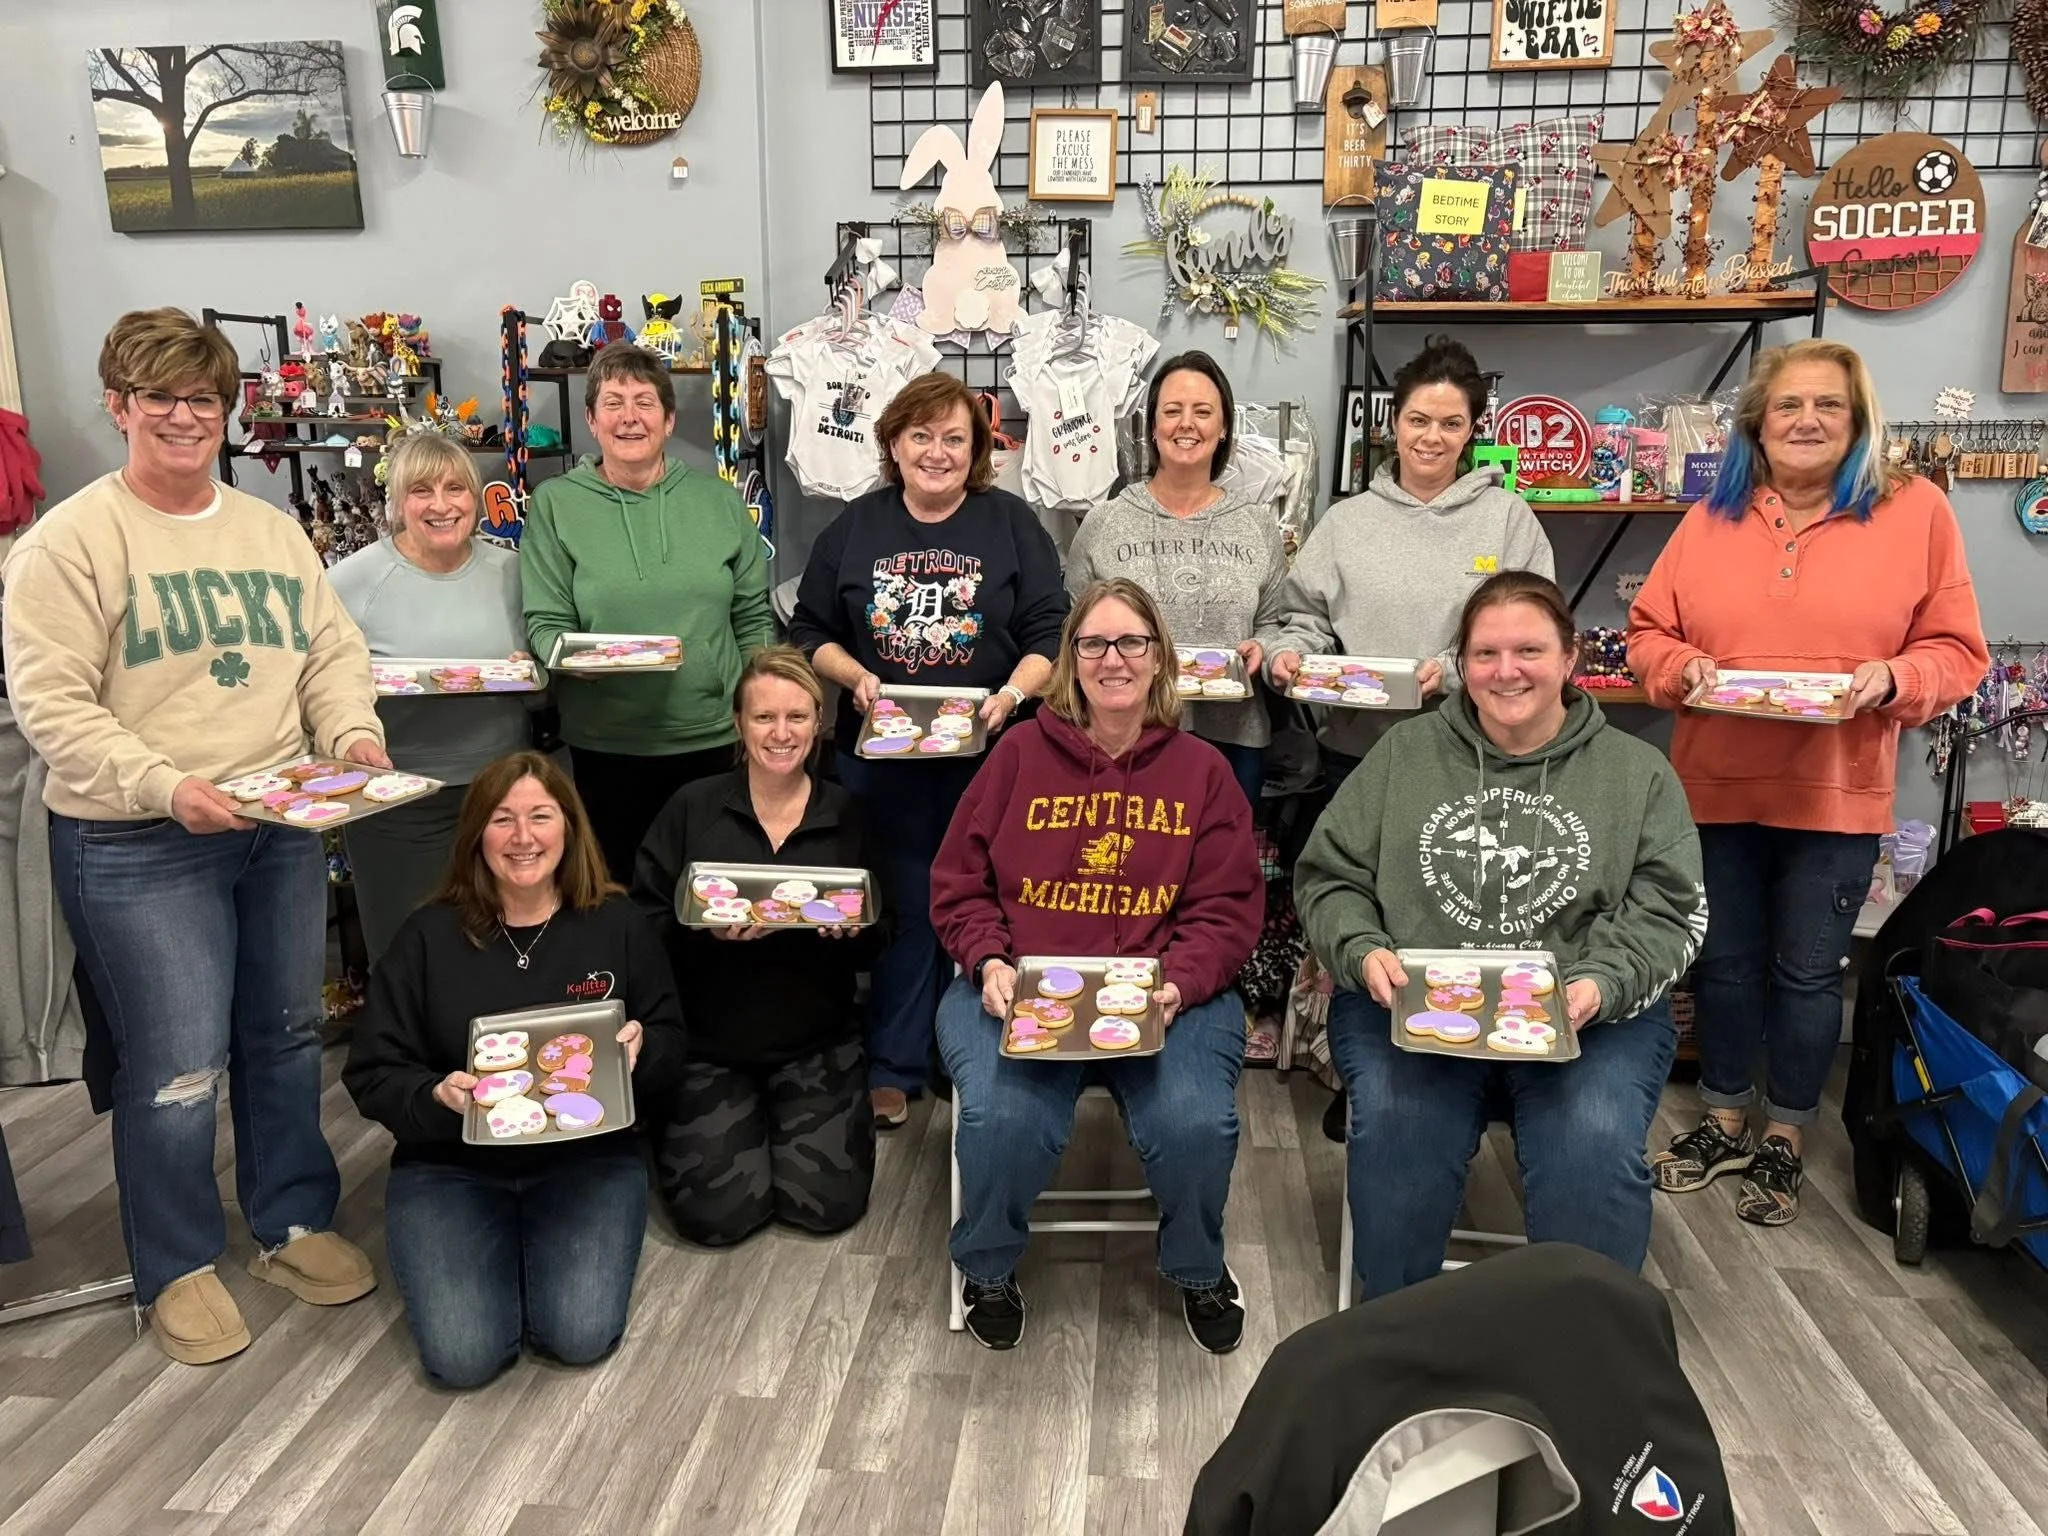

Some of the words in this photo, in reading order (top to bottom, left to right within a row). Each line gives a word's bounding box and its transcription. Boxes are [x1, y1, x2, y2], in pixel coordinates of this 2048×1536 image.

[847, 18, 855, 61] SCRUBS
[914, 4, 923, 62] PATIENT
[1525, 26, 1580, 59] ERA
[606, 108, 682, 131] welcome
[1346, 123, 1365, 135] IT'S
[1056, 130, 1091, 142] PLEASE
[1344, 140, 1366, 152] BEER
[1056, 144, 1091, 156] EXCUSE
[1339, 155, 1372, 168] THIRTY
[1053, 157, 1068, 170] THE
[1072, 157, 1094, 170] MESS
[1833, 165, 1909, 200] Hello
[1432, 194, 1480, 209] BEDTIME
[1434, 214, 1470, 227] STORY
[1812, 198, 1977, 242] SOCCER
[1166, 205, 1296, 288] family
[1562, 253, 1590, 266] WELCOME
[1720, 253, 1798, 288] Blessed
[1564, 267, 1572, 279] TO
[1573, 267, 1586, 279] OUR
[1603, 267, 1679, 294] Thankful
[702, 282, 714, 293] FUCK
[826, 381, 843, 390] BOR
[817, 422, 865, 444] DETROIT!
[1051, 412, 1094, 439] GRANDMA
[1547, 414, 1575, 448] 2
[1518, 452, 1573, 460] INTENDO
[1695, 469, 1719, 477] TAK
[1117, 539, 1185, 562] OUTER
[1192, 538, 1253, 565] BANKS
[873, 548, 981, 579] DETROIT
[1473, 554, 1498, 574] M
[122, 567, 311, 669] LUCKY
[873, 630, 975, 675] Tigers
[1026, 791, 1191, 836] CENTRAL
[1444, 815, 1460, 830] NO
[1457, 806, 1477, 819] SAL
[1521, 807, 1535, 815] NO
[1500, 820, 1509, 829] N
[1418, 802, 1454, 888] MICHIGAN
[1455, 849, 1467, 859] W
[1547, 846, 1556, 856] E
[1562, 811, 1592, 872] HURON
[1440, 871, 1459, 894] LIFE
[1557, 863, 1571, 881] NO
[1017, 877, 1180, 917] MICHIGAN
[1455, 891, 1476, 911] AKE
[1500, 894, 1509, 904] S
[1439, 898, 1483, 932] ERIE
[1500, 885, 1578, 936] ONTARIO
[1519, 939, 1543, 950] City
[566, 980, 607, 995] Kalitta
[1611, 1479, 1632, 1516] MATERIEL
[1629, 1440, 1654, 1479] COMMAND
[1612, 1475, 1625, 1491] U.S.
[1621, 1453, 1638, 1477] ARMY
[1685, 1492, 1706, 1526] STRONG
